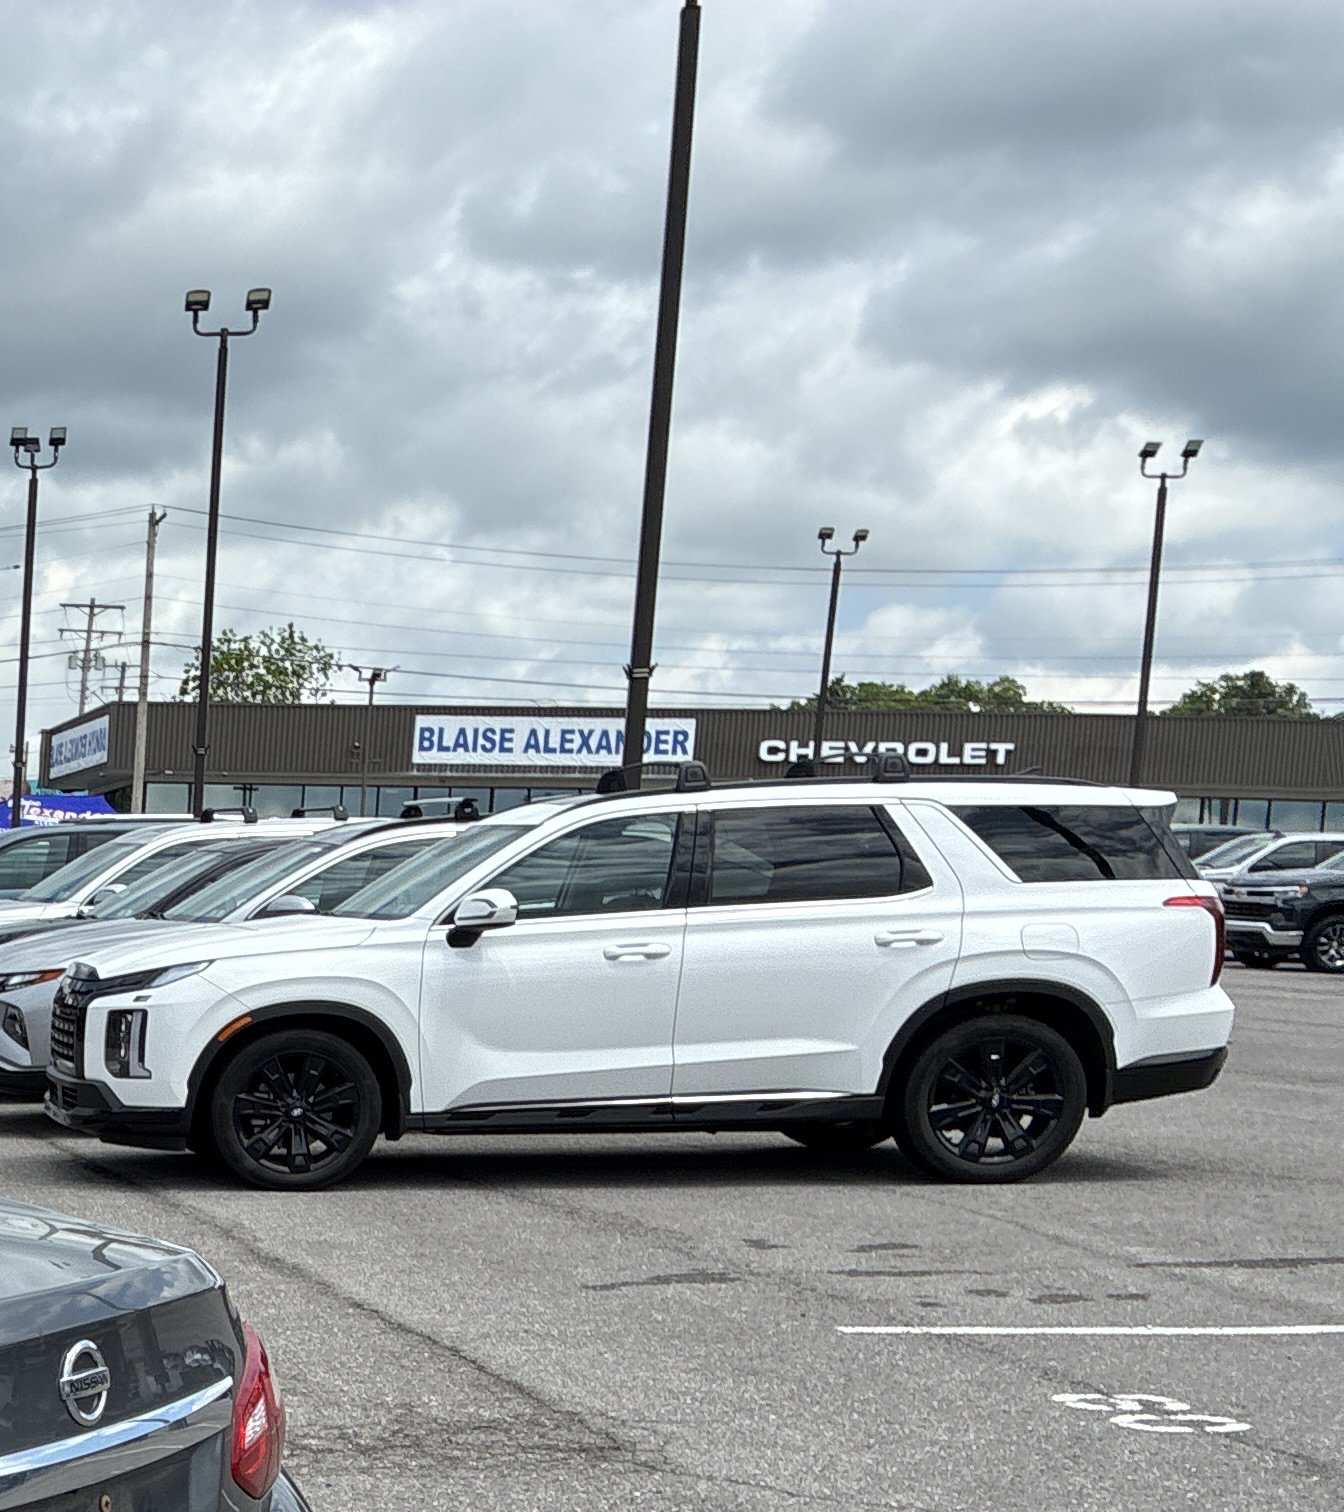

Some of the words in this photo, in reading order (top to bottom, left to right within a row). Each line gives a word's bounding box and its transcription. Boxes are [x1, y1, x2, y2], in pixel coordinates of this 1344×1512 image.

[417, 727, 515, 754] BLAISE
[758, 740, 1016, 765] CHEVROLET
[69, 1373, 109, 1393] NISSAN
